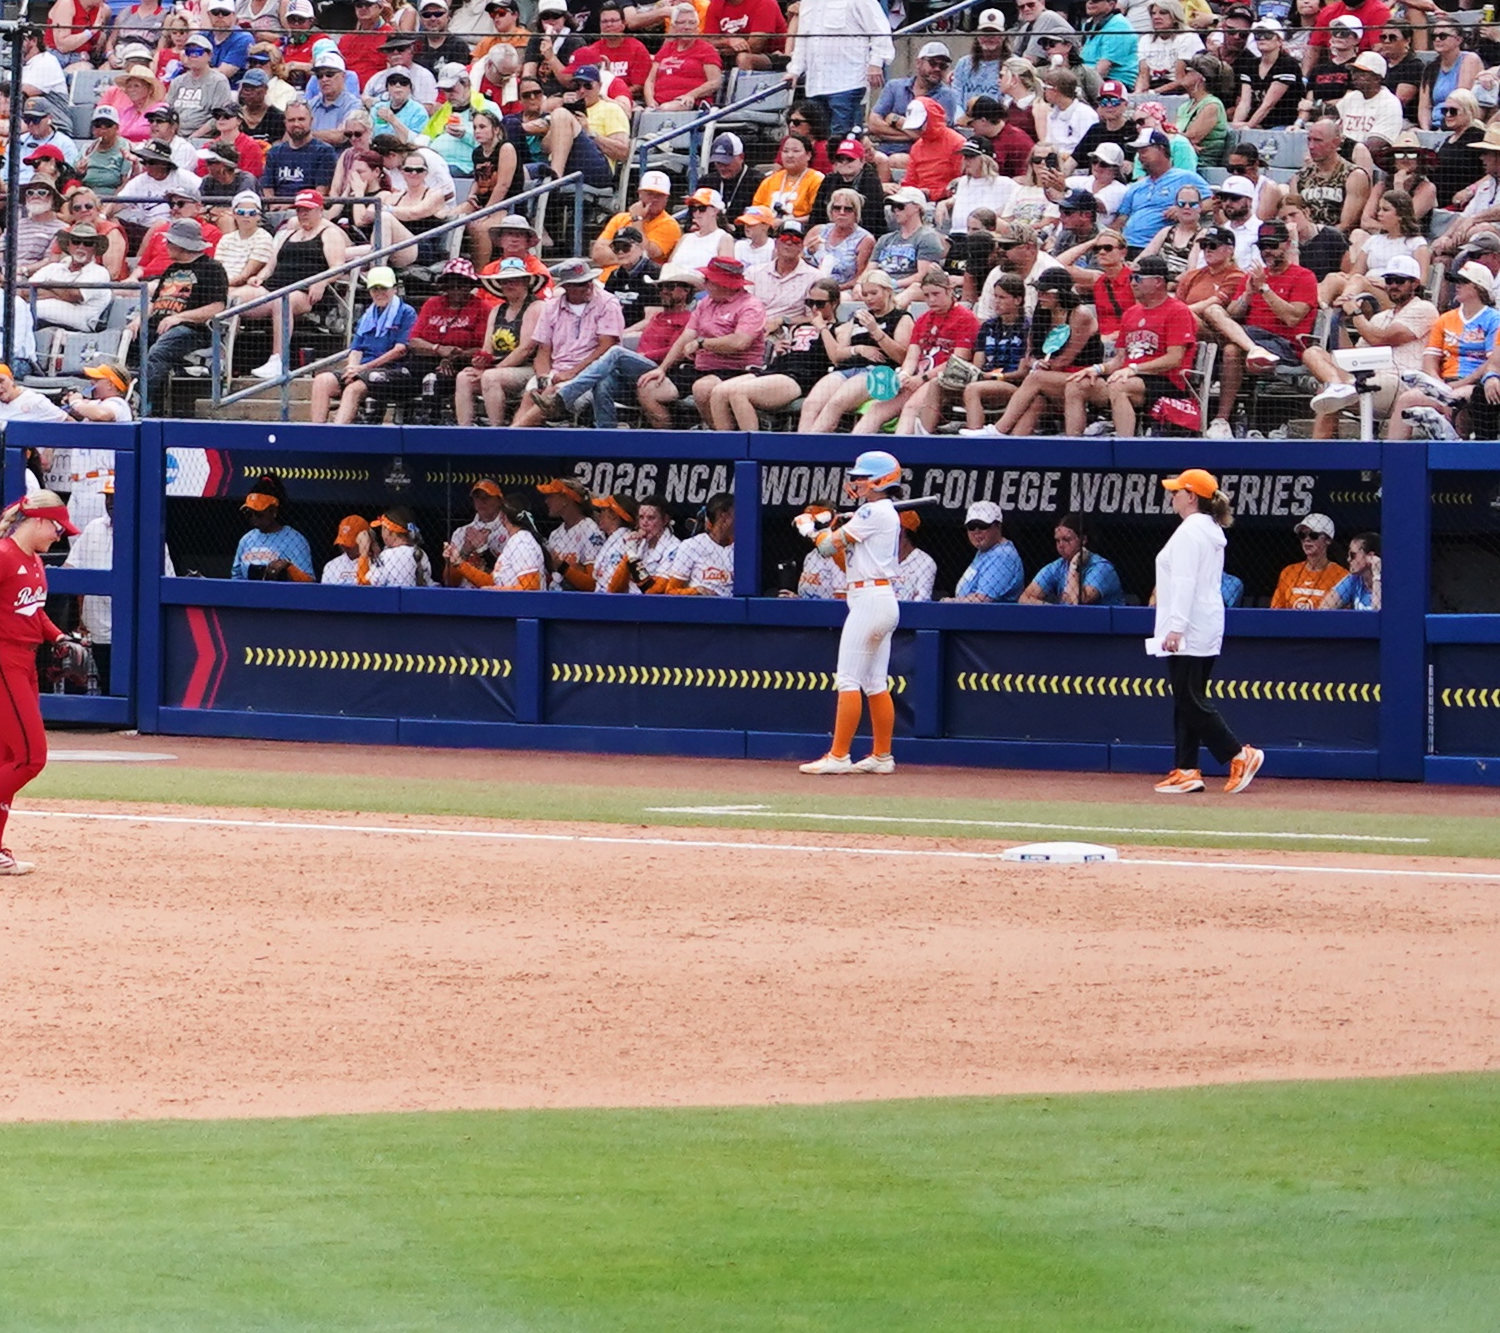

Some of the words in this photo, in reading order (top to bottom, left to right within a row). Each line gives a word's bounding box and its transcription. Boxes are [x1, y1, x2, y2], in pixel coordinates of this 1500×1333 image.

[665, 463, 736, 504] NCA
[922, 469, 1062, 512] COLLEGE
[1219, 474, 1314, 516] ERIES
